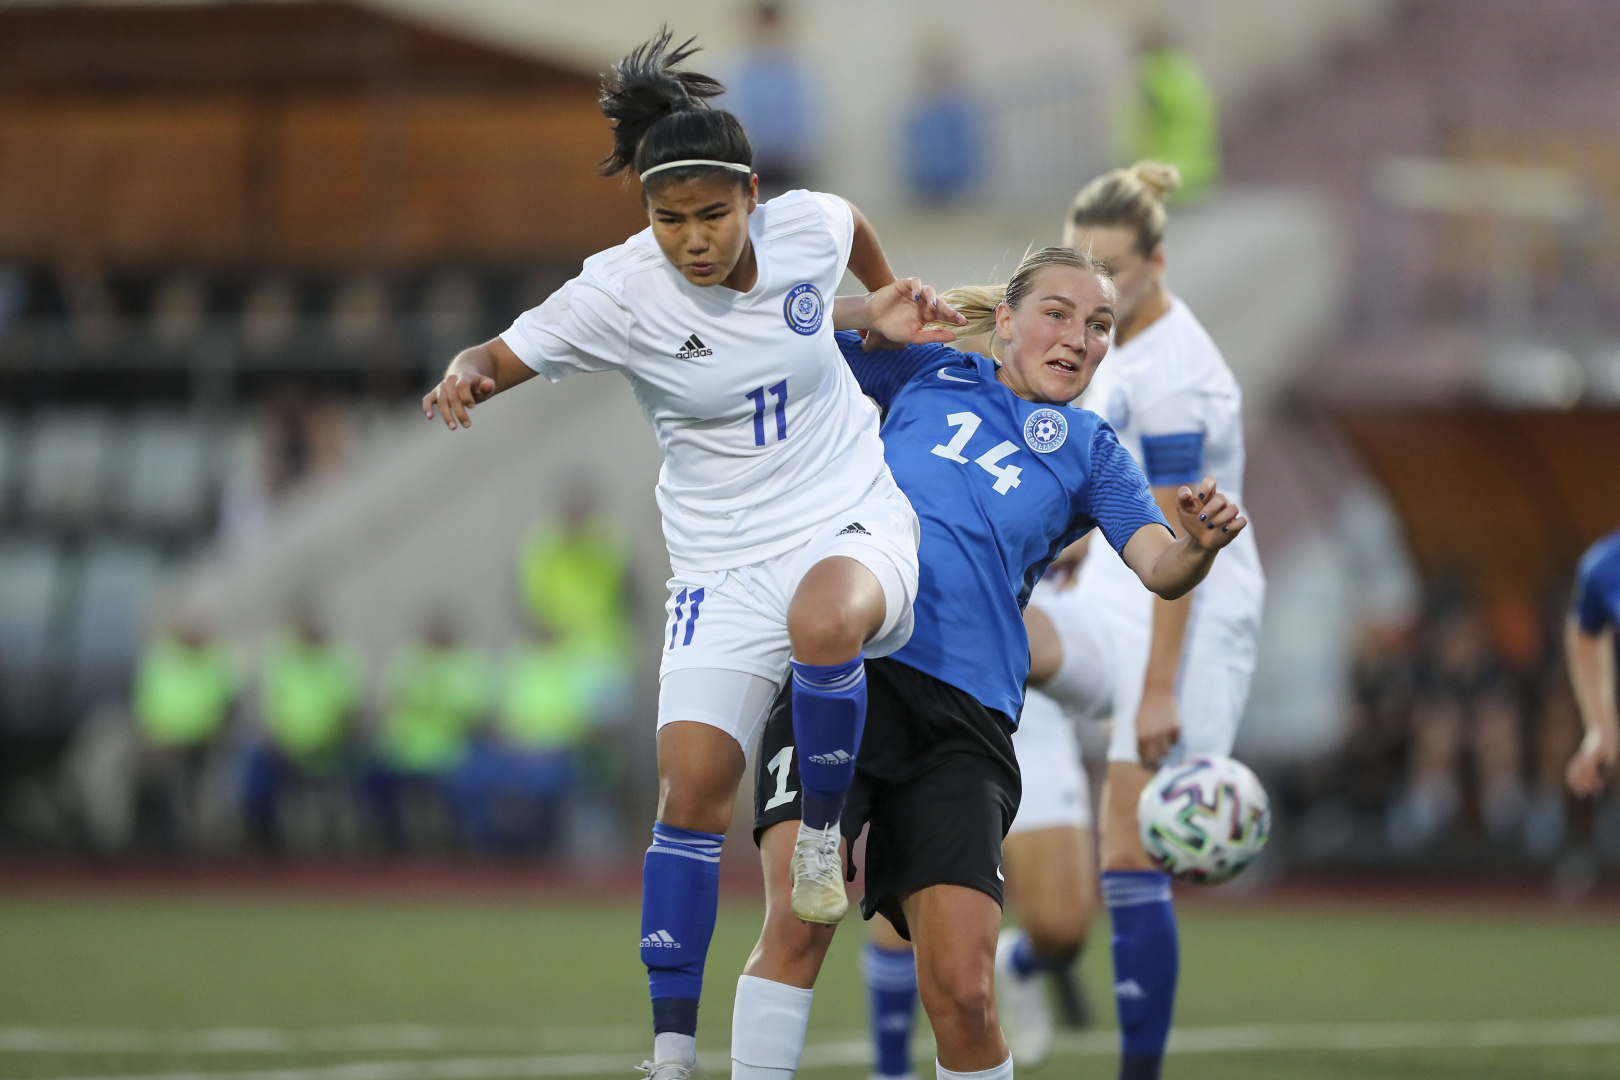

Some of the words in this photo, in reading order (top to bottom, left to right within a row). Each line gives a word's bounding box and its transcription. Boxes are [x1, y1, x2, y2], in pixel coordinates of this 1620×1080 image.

[794, 286, 807, 295] KFF
[675, 347, 713, 360] adidas
[745, 379, 788, 446] 11
[1041, 411, 1064, 425] EESTI
[1052, 431, 1065, 447] LIIT
[930, 411, 1024, 496] 14
[669, 586, 705, 650] 11
[639, 938, 682, 949] adidas
